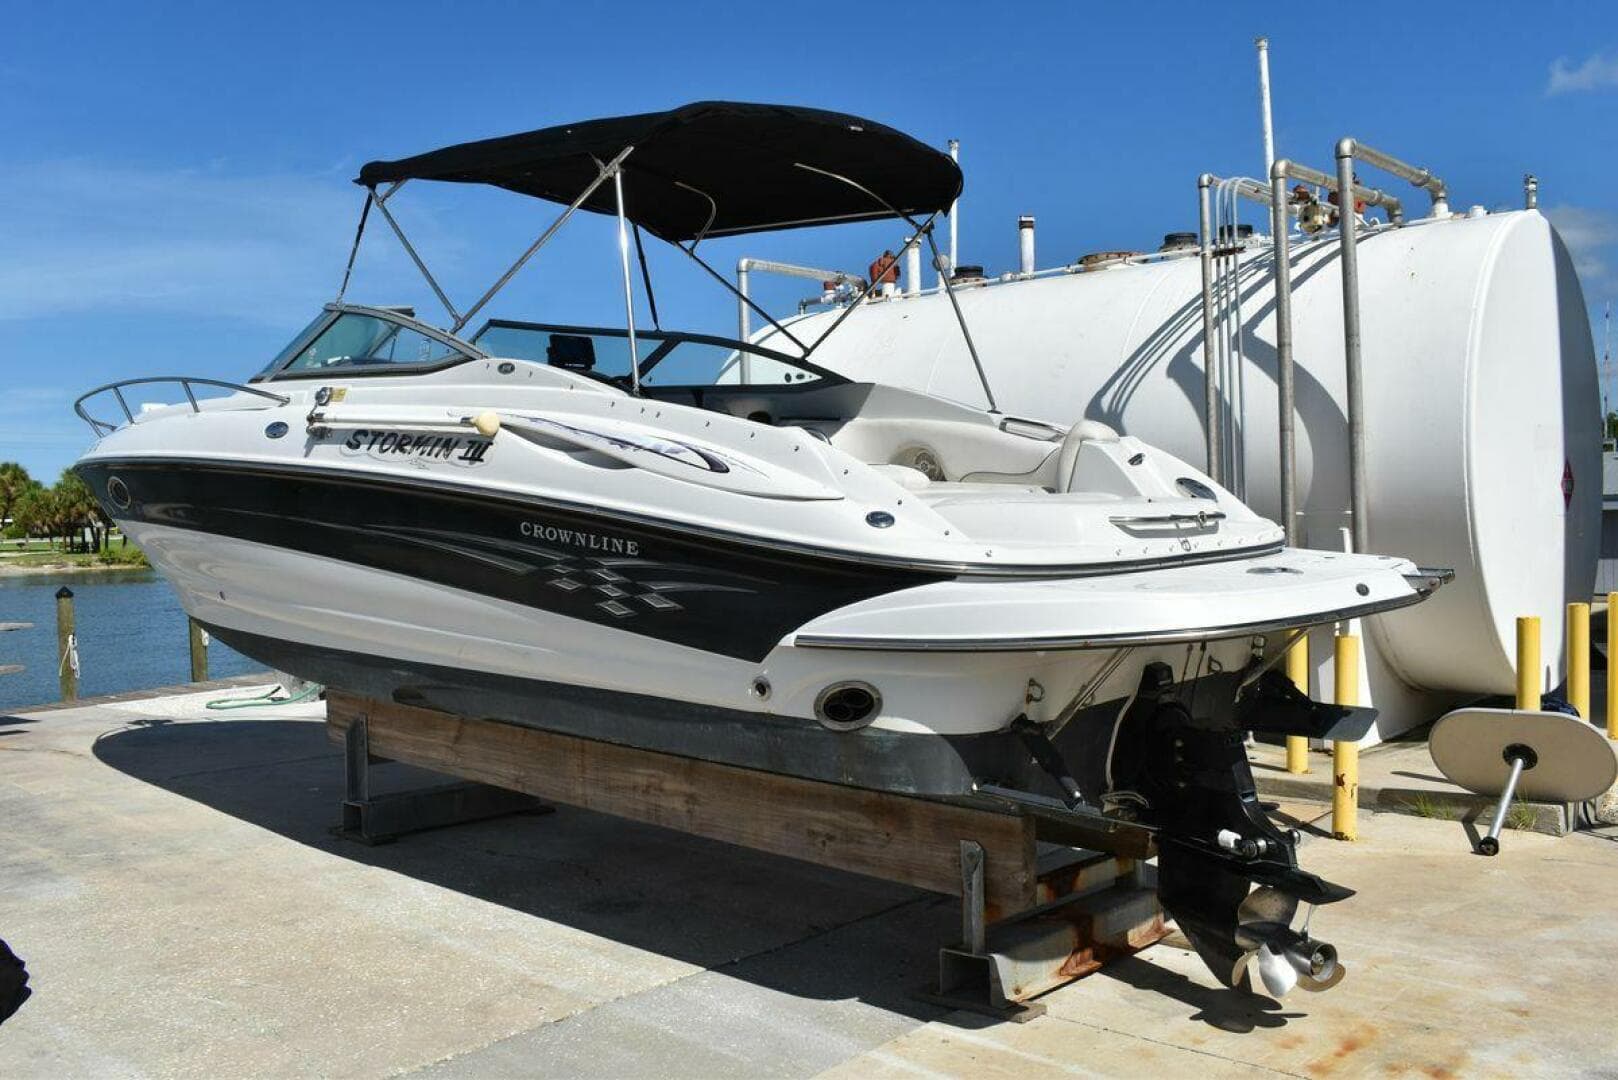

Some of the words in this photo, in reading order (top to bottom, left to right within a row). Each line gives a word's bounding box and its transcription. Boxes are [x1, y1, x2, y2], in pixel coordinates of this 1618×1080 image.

[346, 429, 460, 460] STORMIN
[457, 440, 493, 462] III
[519, 521, 640, 556] CROWNLINE
